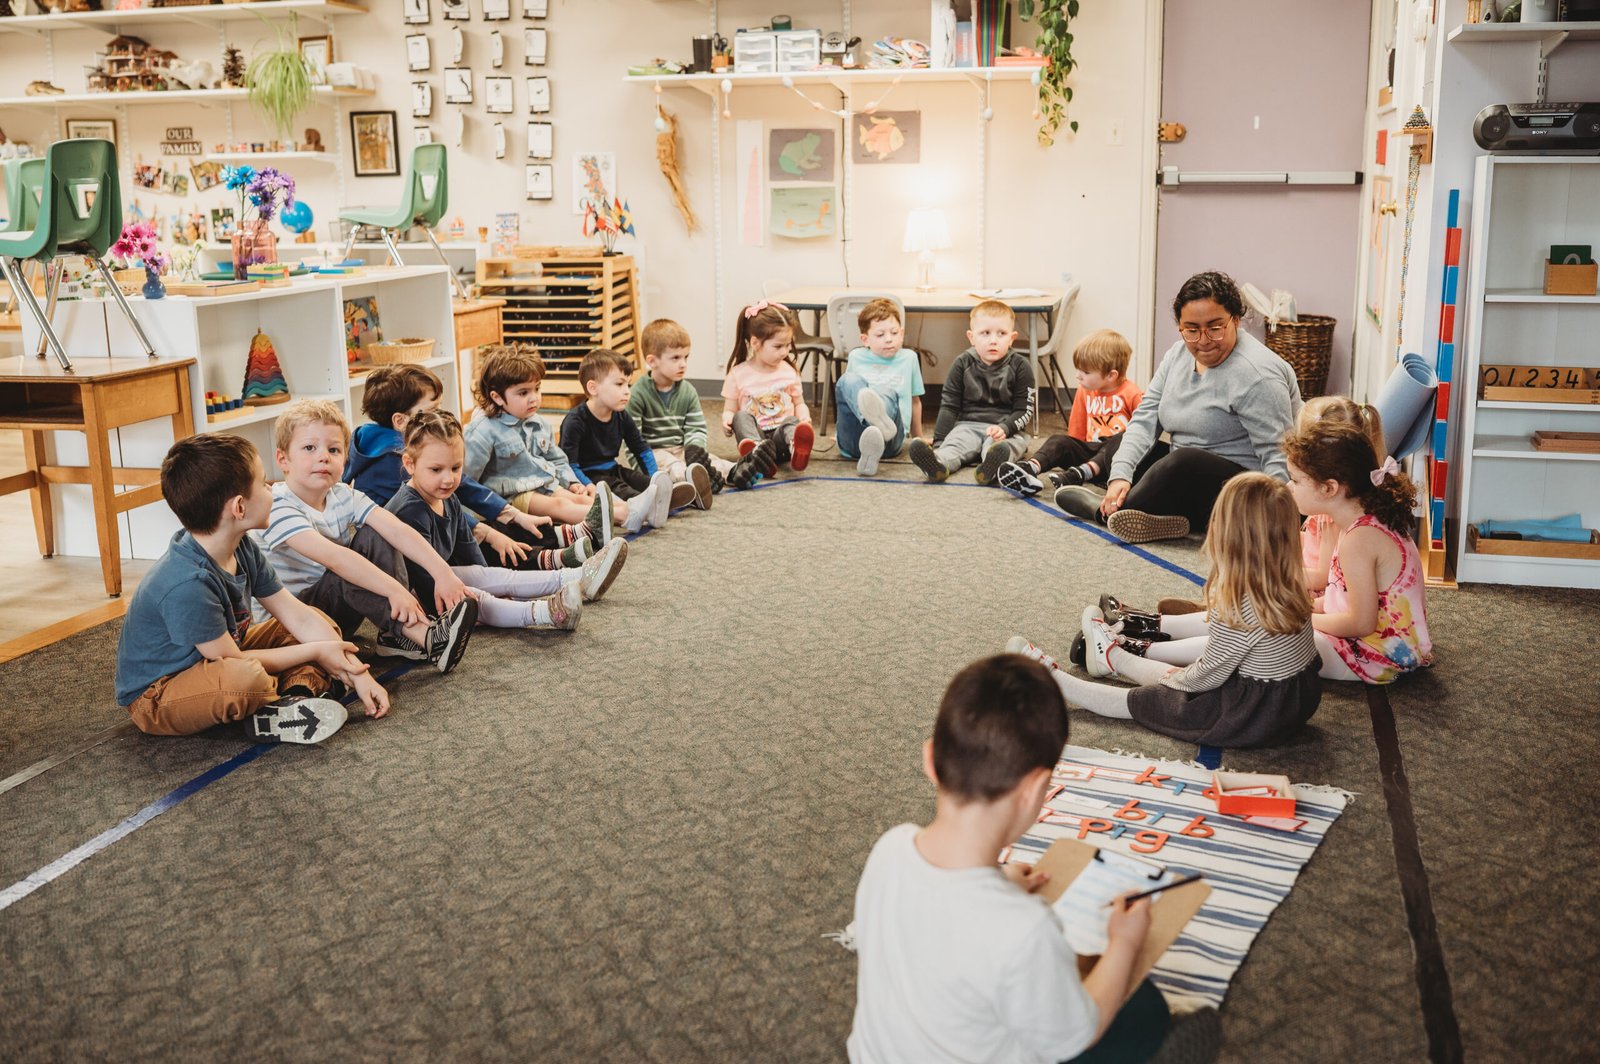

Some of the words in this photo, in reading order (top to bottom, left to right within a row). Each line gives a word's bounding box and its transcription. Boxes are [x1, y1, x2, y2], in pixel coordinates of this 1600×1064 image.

[167, 129, 192, 140] OUR
[161, 143, 201, 154] FAMILY
[1484, 367, 1499, 386] 0
[1525, 368, 1539, 387] 2
[1545, 369, 1560, 388] 3
[1565, 369, 1579, 389] 4
[1086, 395, 1123, 416] WILD
[1076, 817, 1171, 854] pig
